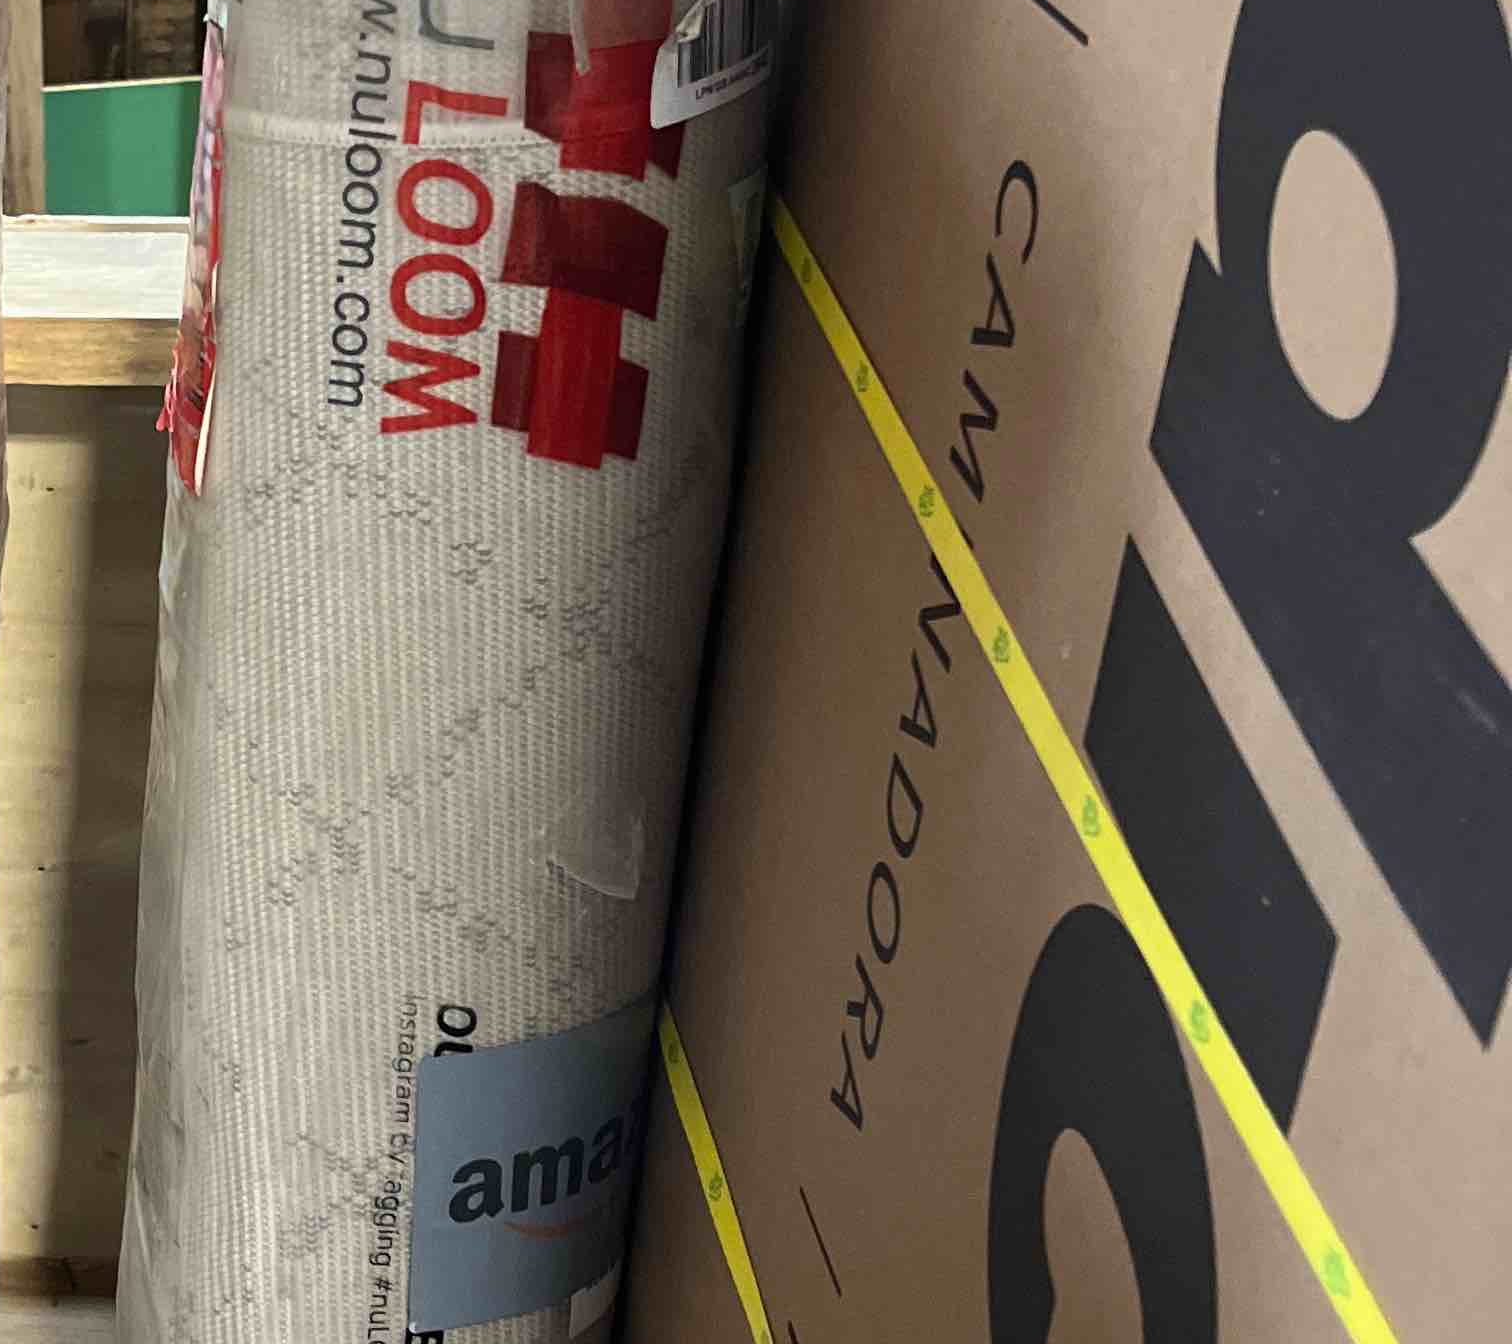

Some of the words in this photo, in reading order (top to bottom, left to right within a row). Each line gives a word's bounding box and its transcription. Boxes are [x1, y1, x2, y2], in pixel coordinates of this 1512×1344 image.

[379, 81, 510, 435] LOOM
[830, 159, 1039, 1130] CAMNADORA
[367, 1175, 406, 1267] agging
[448, 1105, 635, 1224] ama
